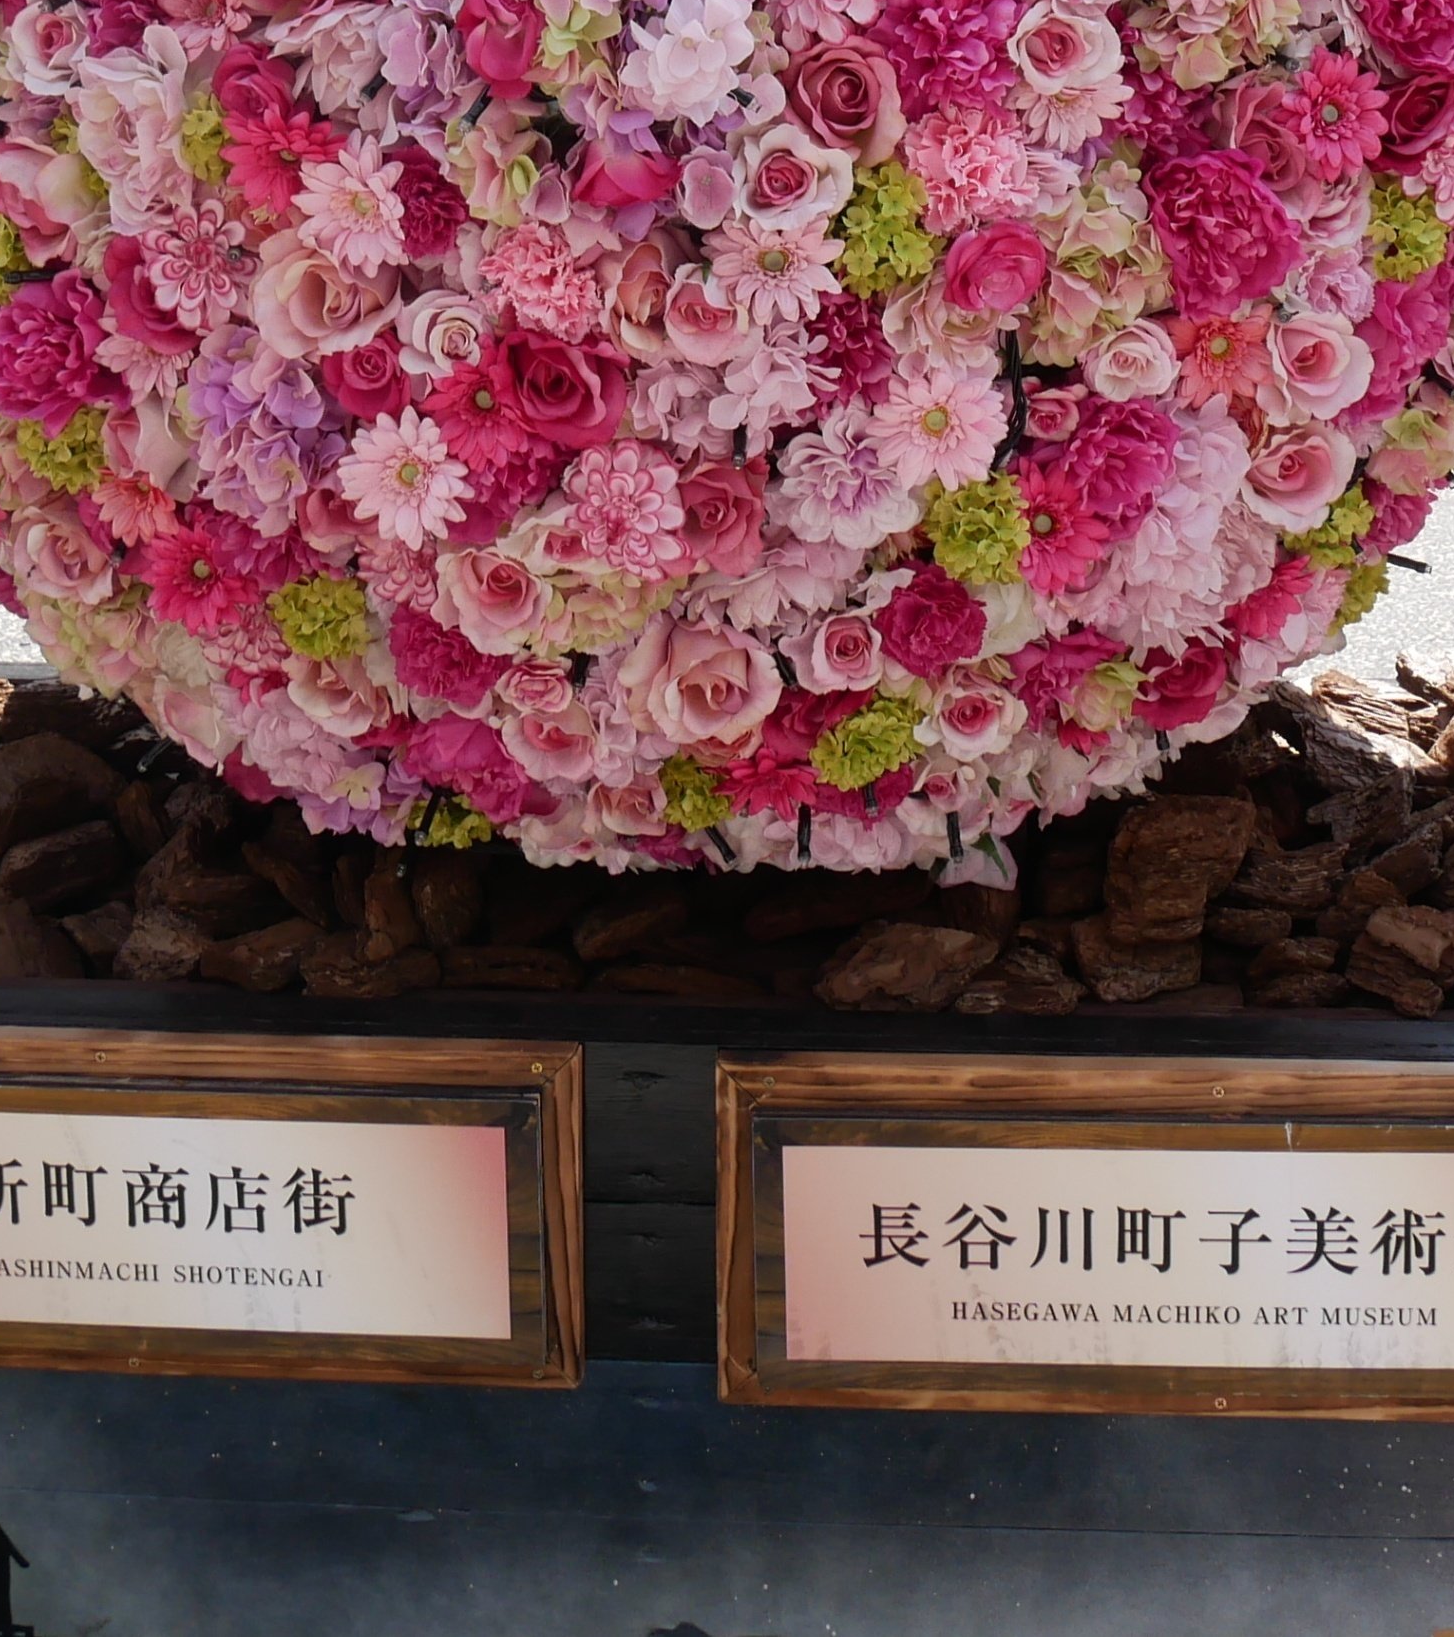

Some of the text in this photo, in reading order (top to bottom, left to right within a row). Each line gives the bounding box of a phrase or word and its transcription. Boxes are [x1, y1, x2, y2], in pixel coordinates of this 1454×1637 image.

[173, 1264, 325, 1288] SHOTENGAI
[950, 1300, 1439, 1327] HASEGAWA MACHIKO ART MUSEUM
